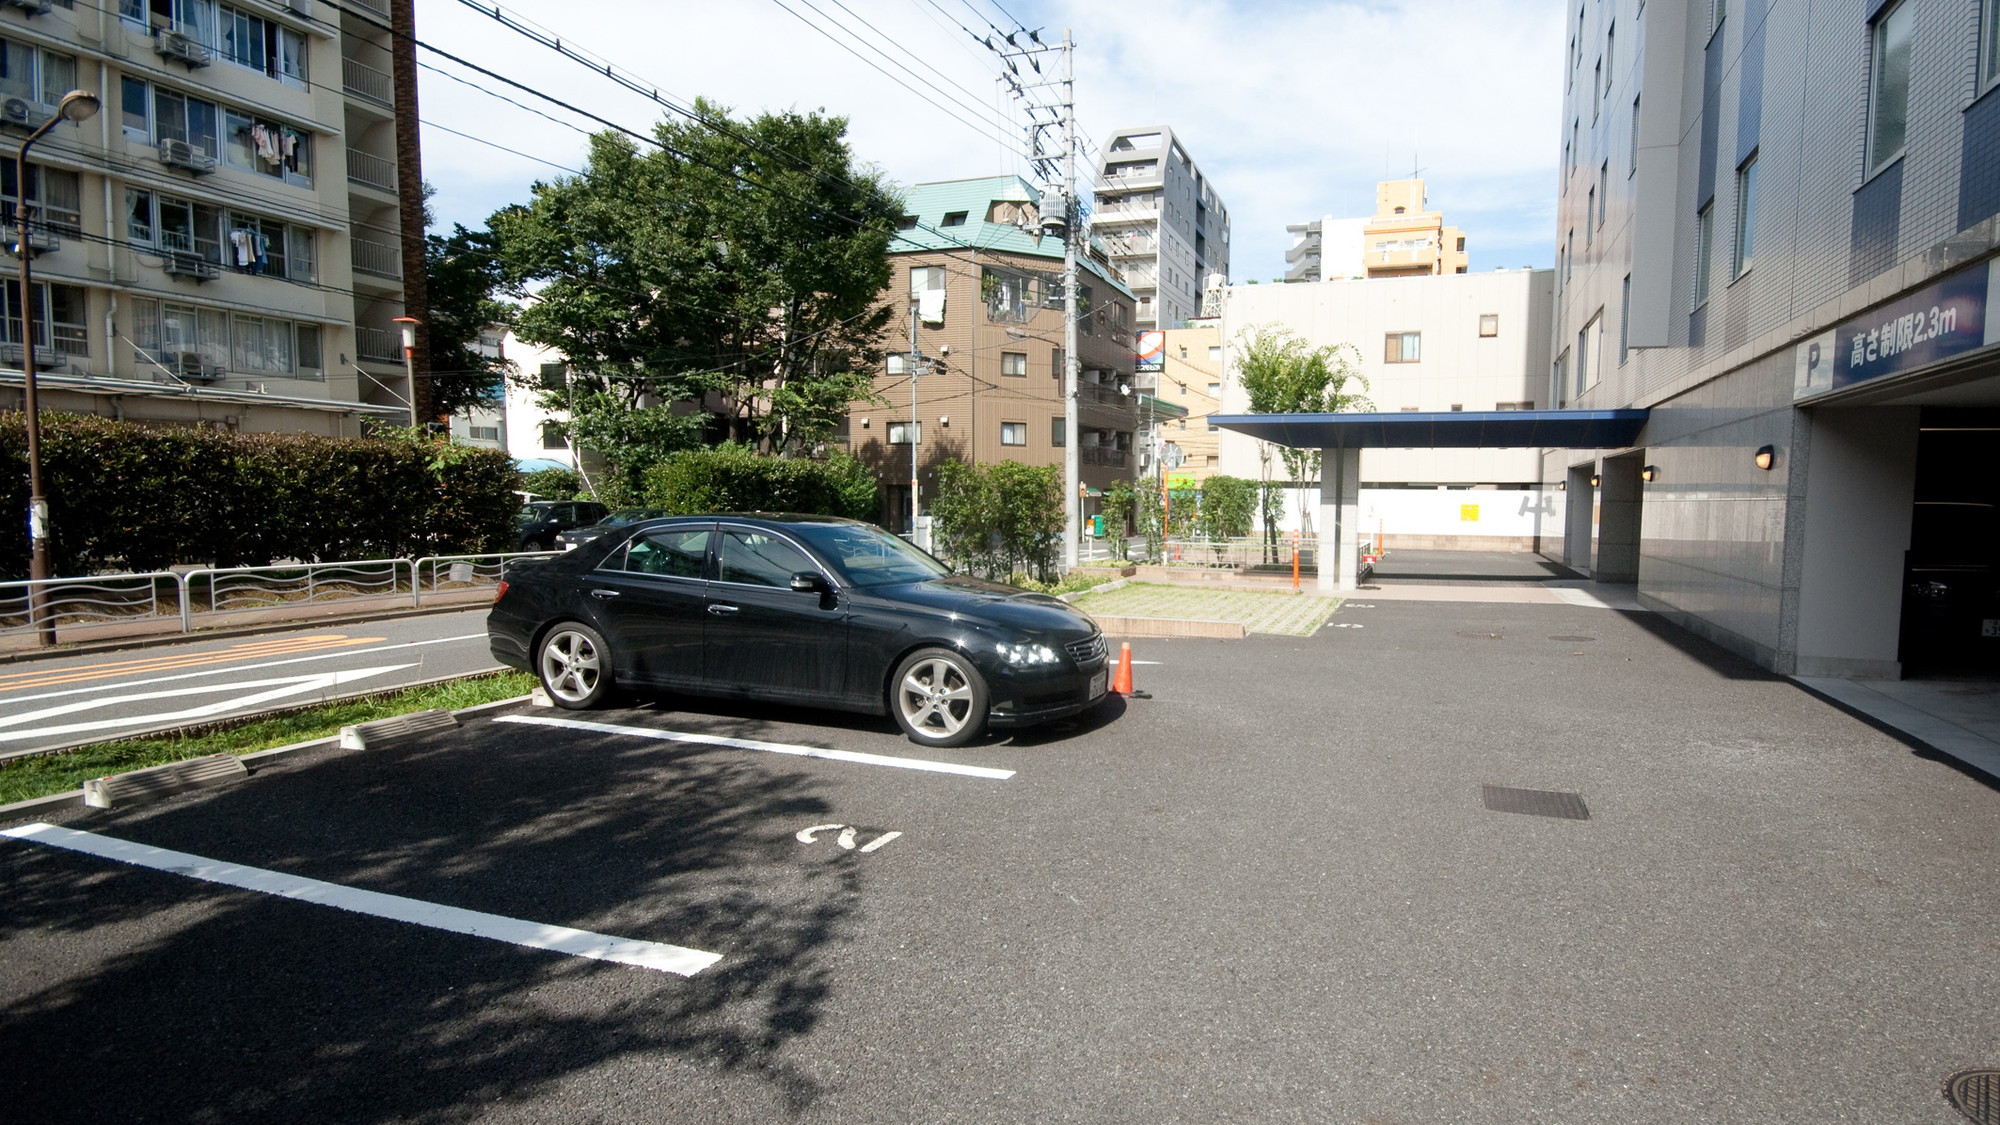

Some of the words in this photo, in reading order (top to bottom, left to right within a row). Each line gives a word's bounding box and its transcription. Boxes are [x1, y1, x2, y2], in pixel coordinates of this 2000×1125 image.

[1851, 306, 1957, 368] 高さ制限2.3m
[1807, 342, 1821, 388] P
